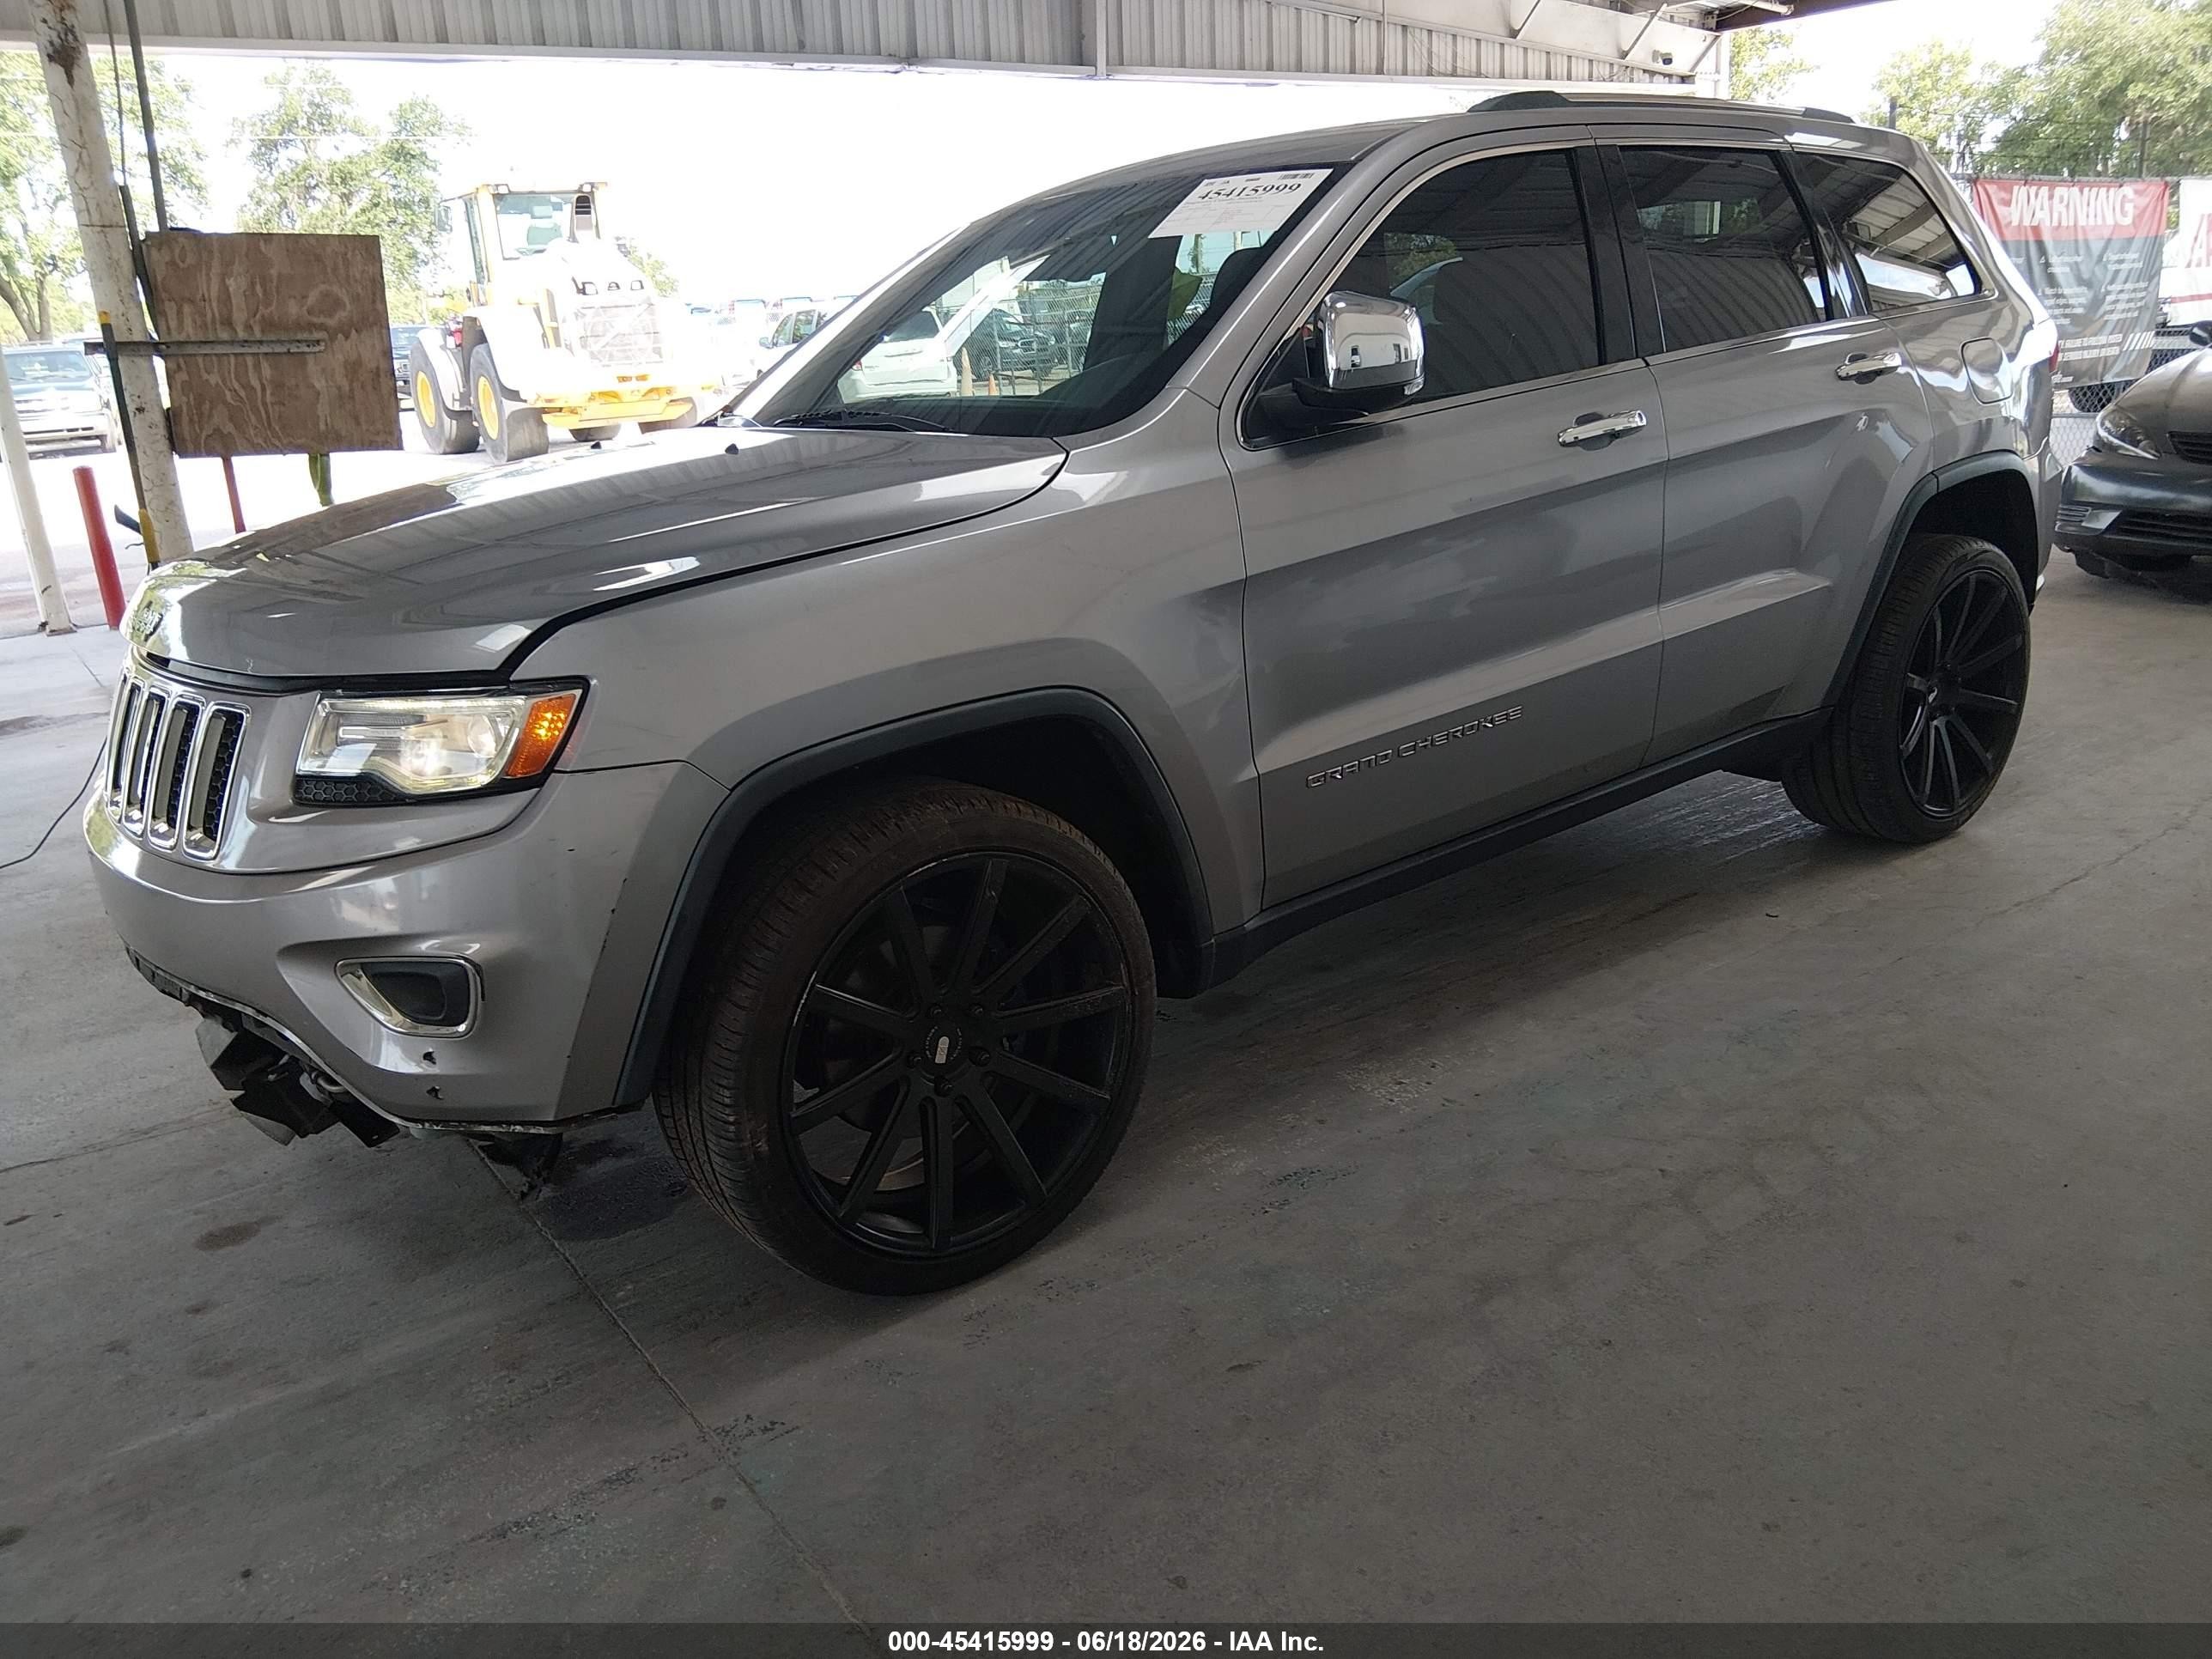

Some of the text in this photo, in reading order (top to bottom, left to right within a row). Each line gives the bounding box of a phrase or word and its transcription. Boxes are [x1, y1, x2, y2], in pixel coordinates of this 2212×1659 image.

[1197, 182, 1303, 200] 45415999
[2010, 185, 2136, 228] WARNING
[1306, 705, 1523, 788] GRAND CHEROKEE
